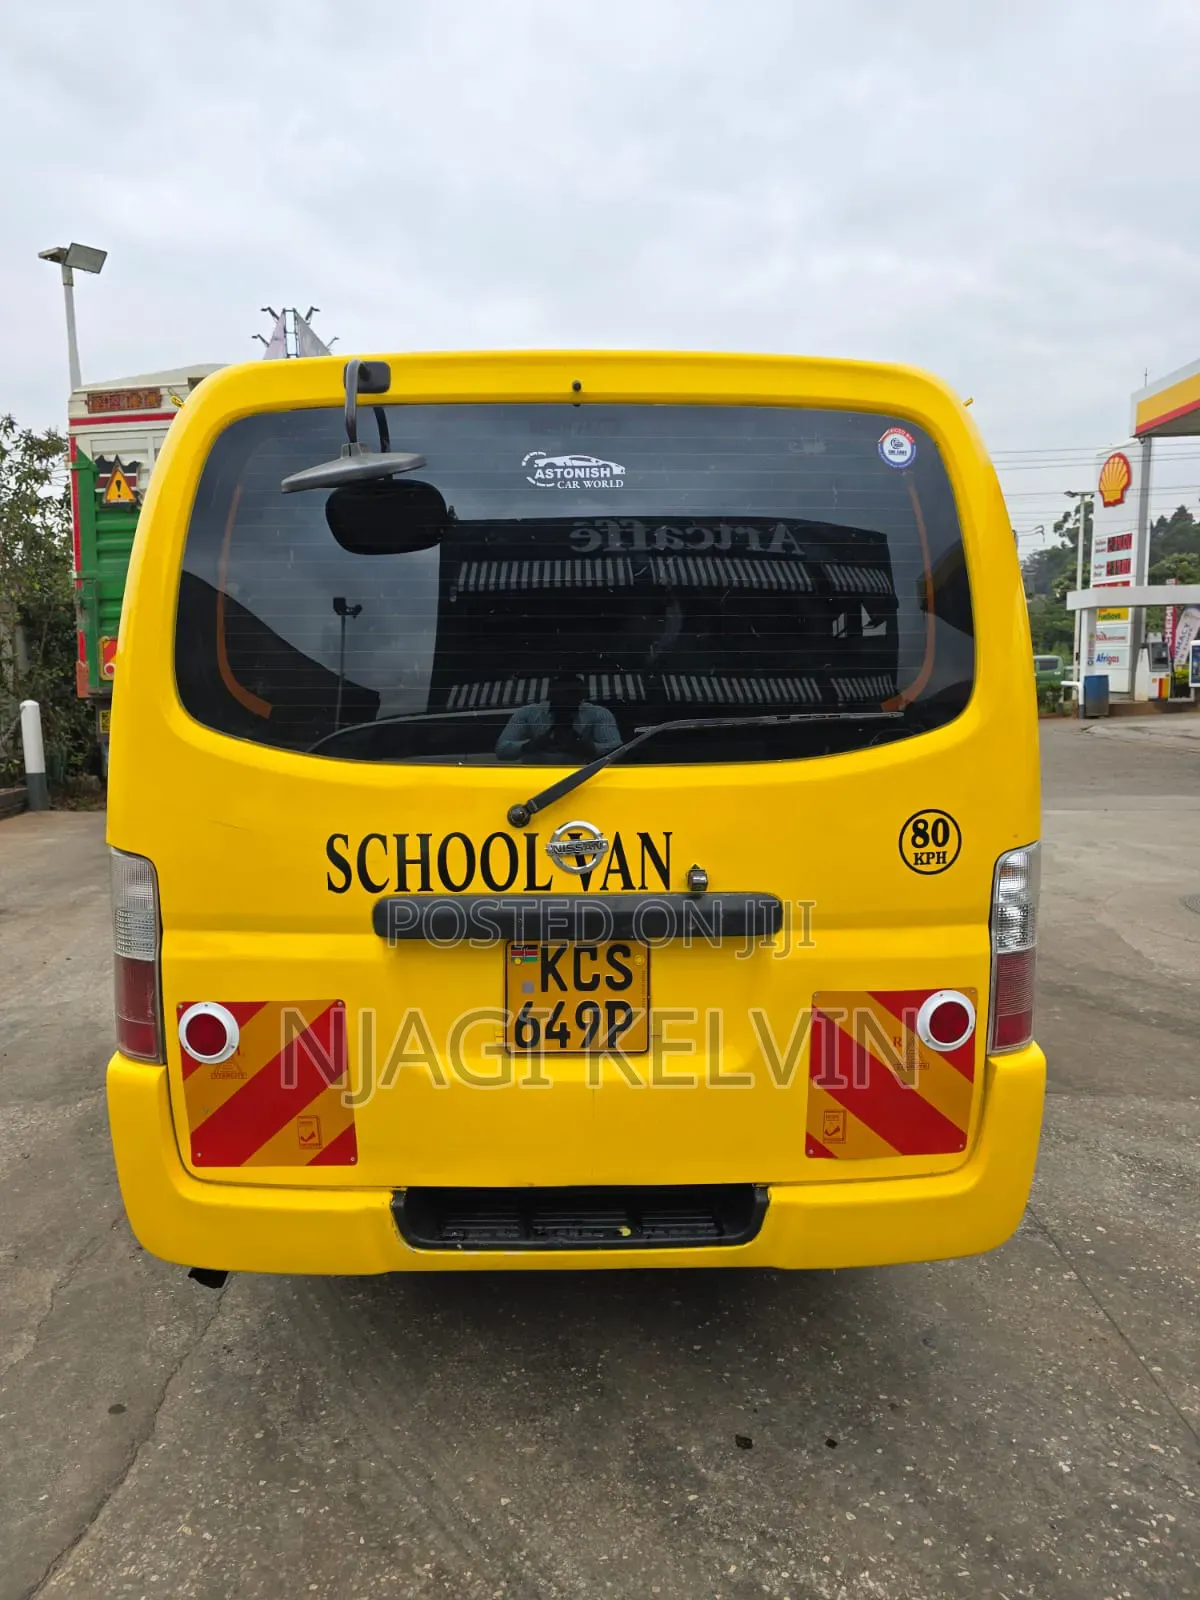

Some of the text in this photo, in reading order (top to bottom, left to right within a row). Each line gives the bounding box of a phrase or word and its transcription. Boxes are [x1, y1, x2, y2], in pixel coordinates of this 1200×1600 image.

[534, 467, 611, 480] ASTONISH
[556, 479, 625, 489] CAR WORLD
[911, 817, 950, 849] 80
[551, 840, 603, 855] NISSAN
[913, 851, 948, 866] KPH
[326, 831, 553, 894] SCHOOL
[540, 943, 634, 993] KCS
[514, 1000, 633, 1049] 649P
